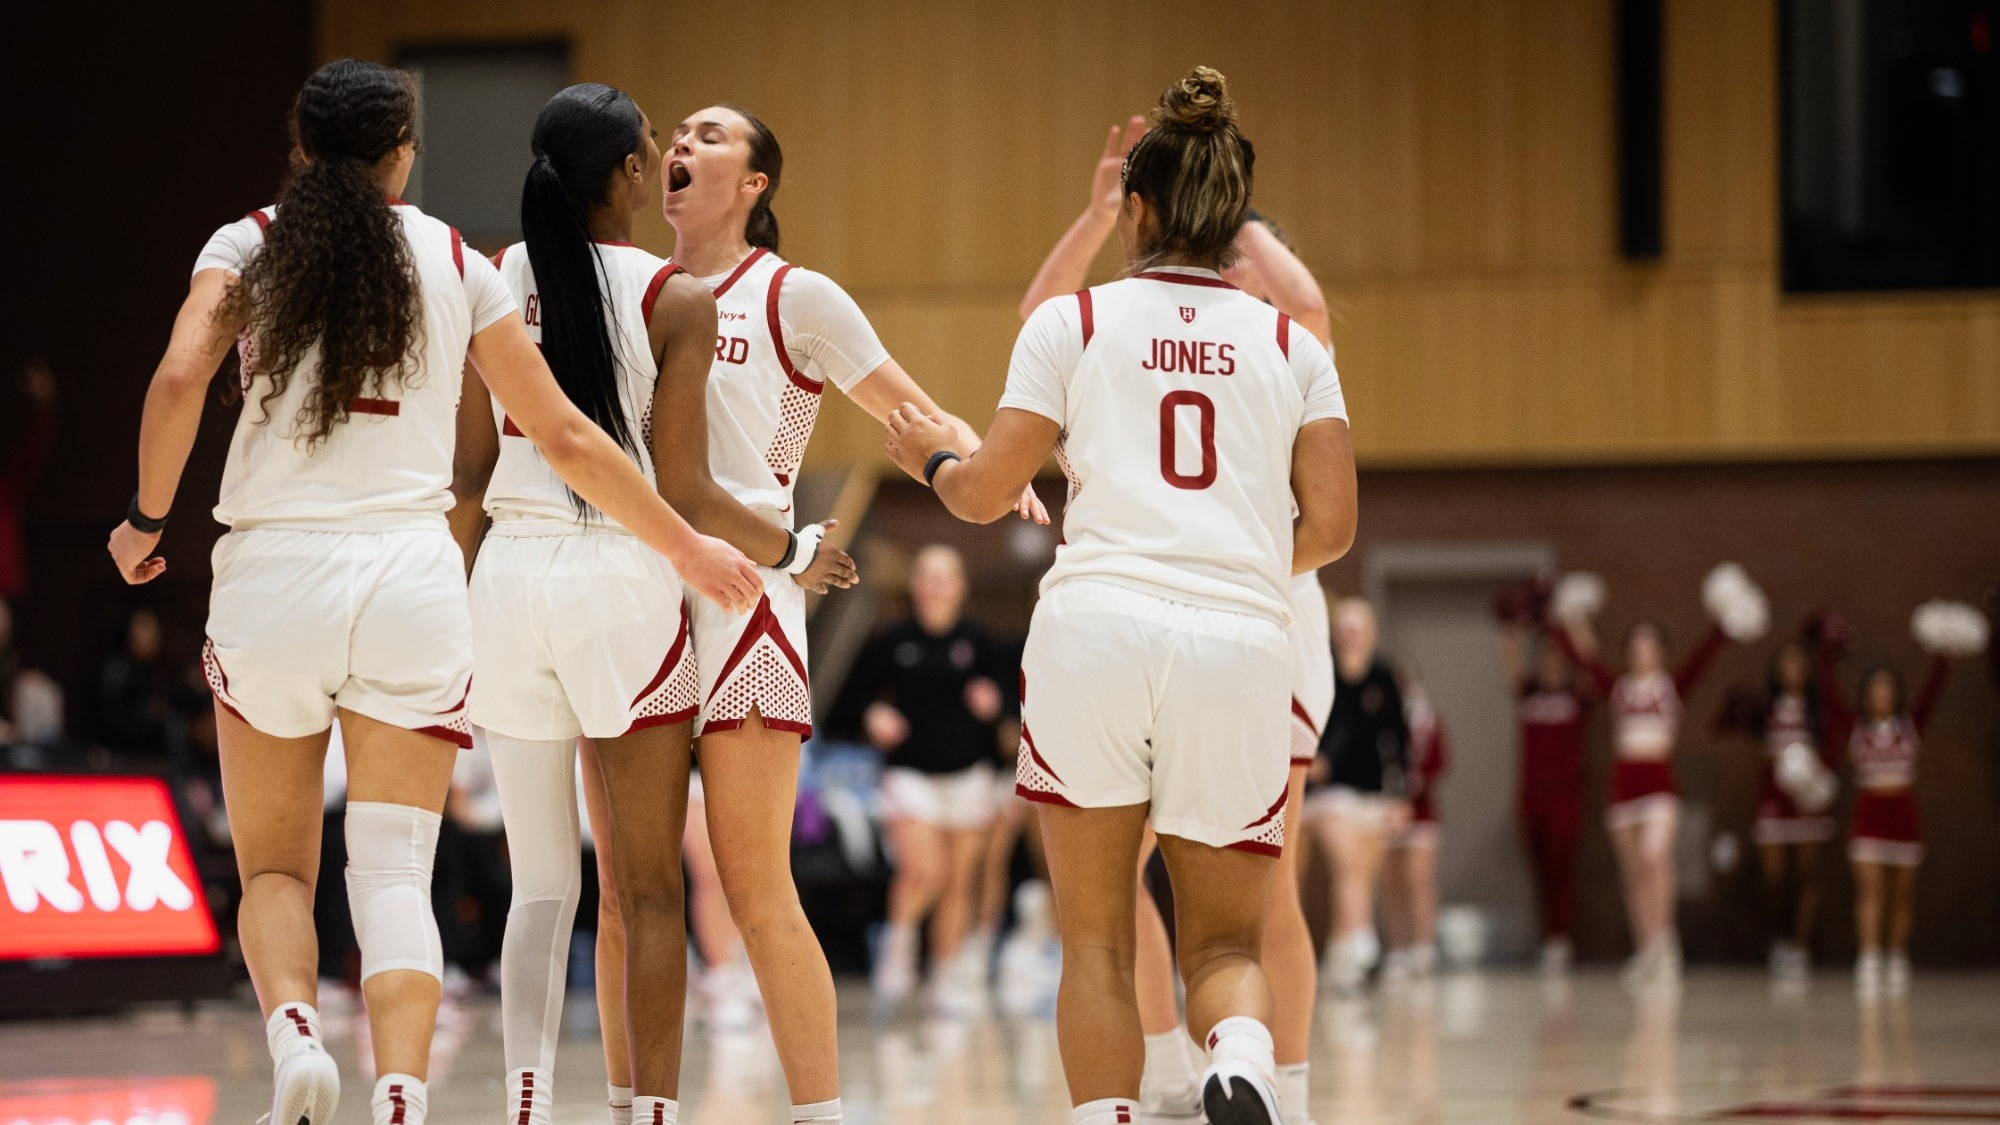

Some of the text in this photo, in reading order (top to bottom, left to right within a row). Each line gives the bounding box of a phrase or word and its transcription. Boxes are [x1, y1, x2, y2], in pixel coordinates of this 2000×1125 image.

[718, 311, 737, 321] Ivy
[716, 336, 749, 365] RD
[1142, 338, 1235, 376] JONES
[1160, 390, 1218, 490] 0
[0, 820, 194, 913] RIX
